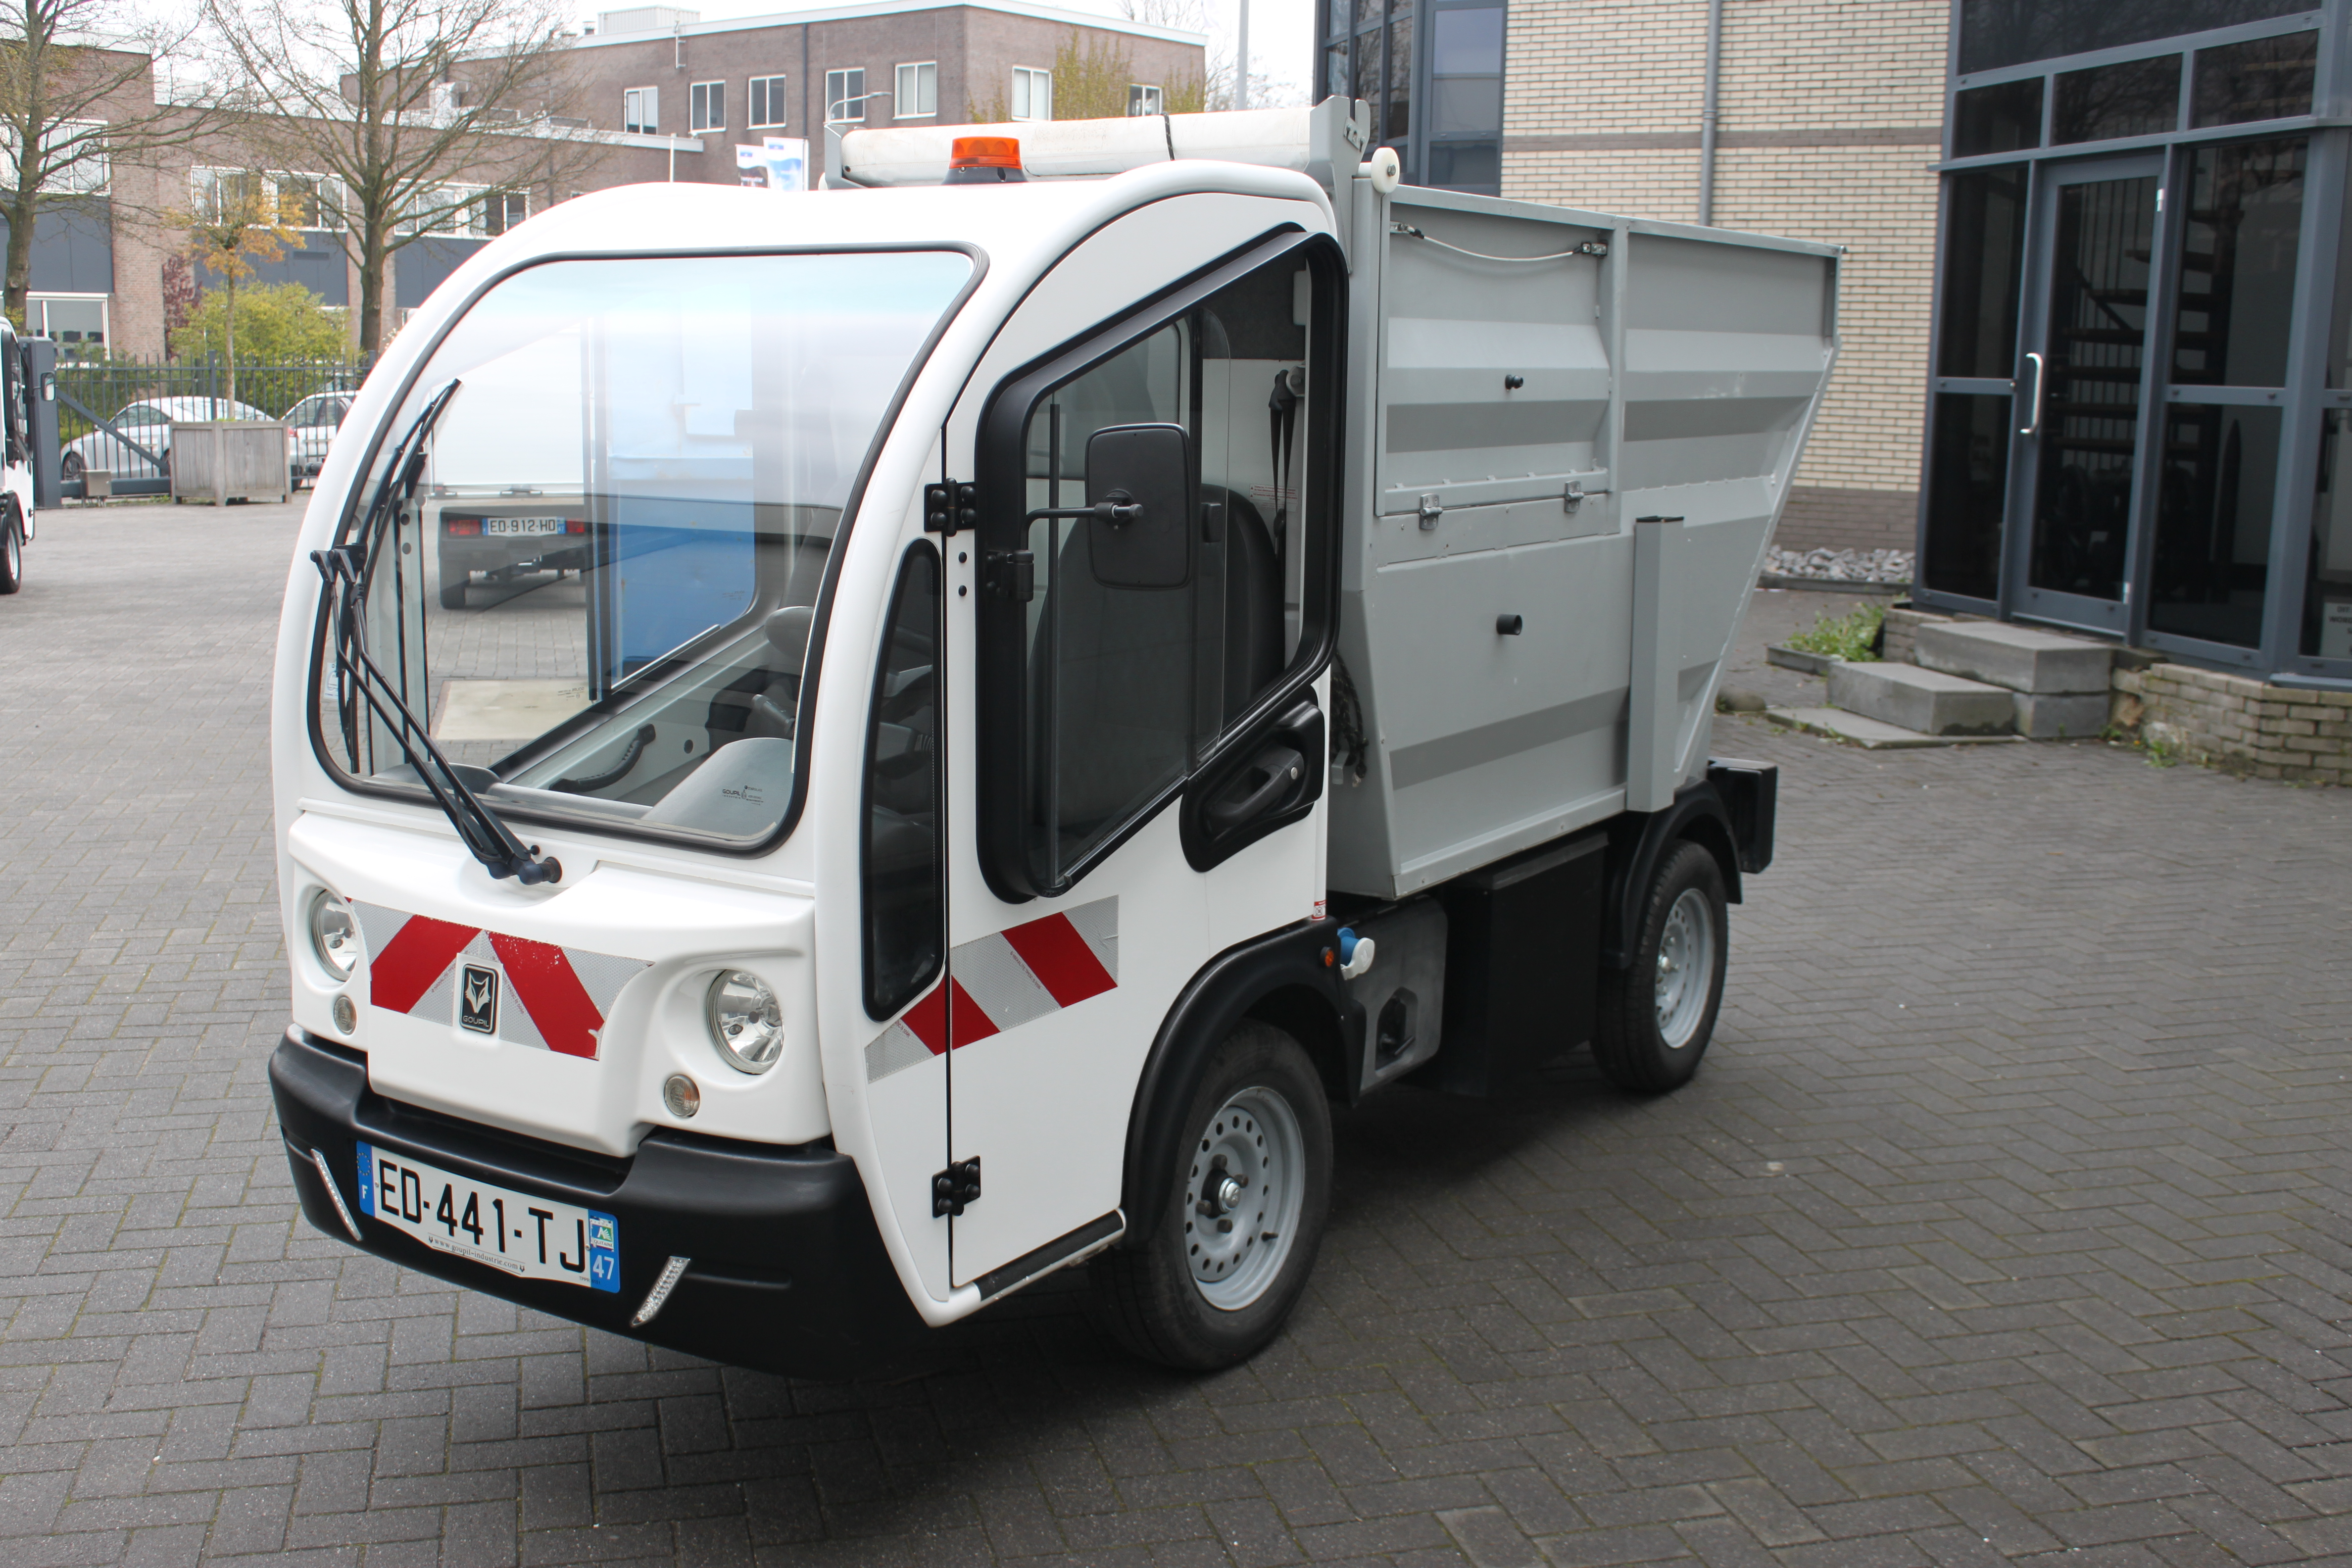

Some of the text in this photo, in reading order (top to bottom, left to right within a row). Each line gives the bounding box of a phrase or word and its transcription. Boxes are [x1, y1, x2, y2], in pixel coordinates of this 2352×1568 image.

[490, 519, 556, 533] ED-912-HD
[463, 1015, 490, 1028] GOUPIL
[361, 1184, 367, 1199] F
[379, 1159, 585, 1273] ED-441-TJ
[594, 1239, 613, 1248] QUITAINE
[434, 1238, 518, 1270] www.goupil-industrie.com
[593, 1254, 614, 1280] 47
